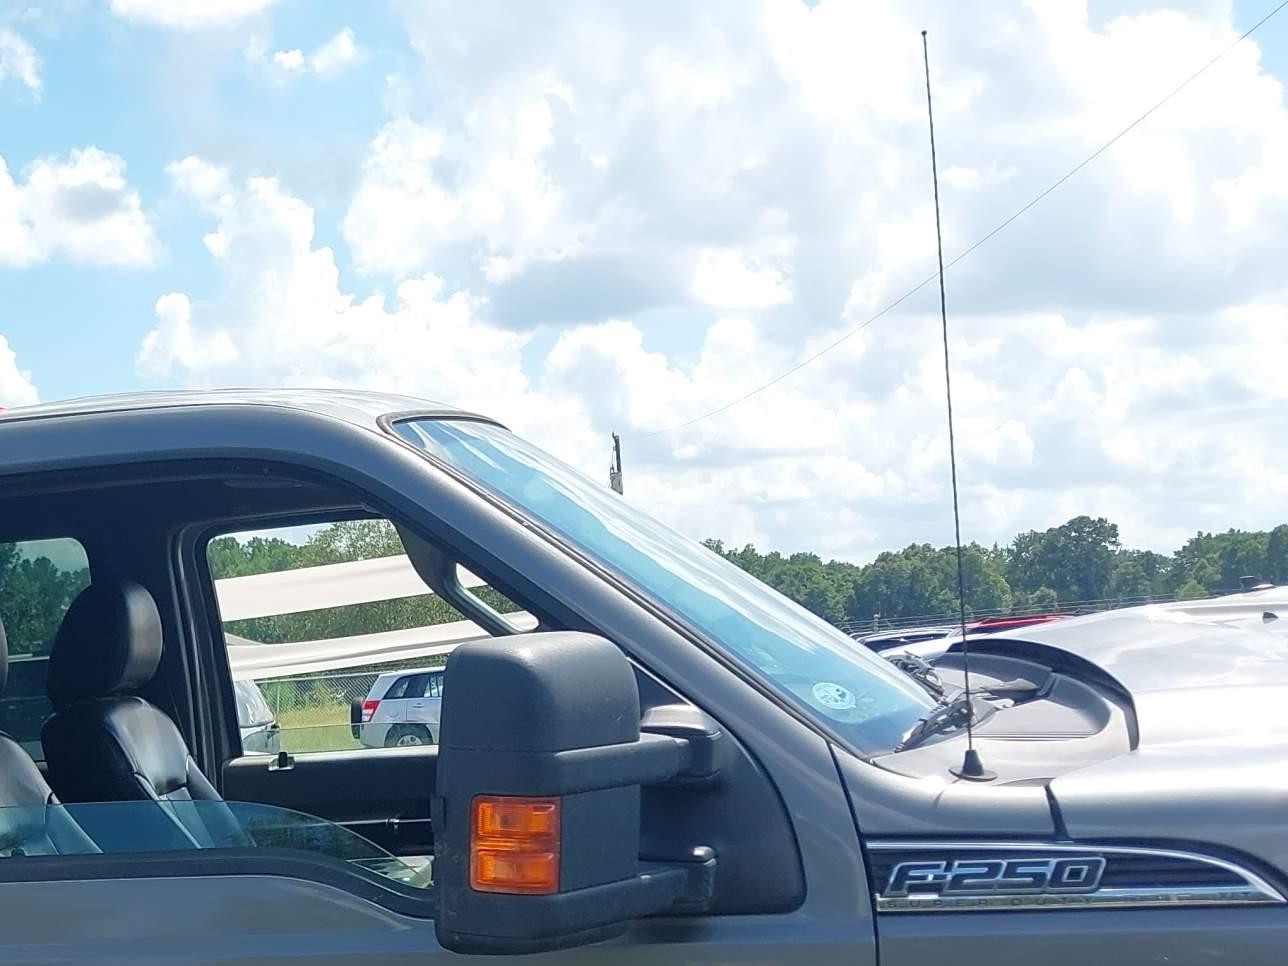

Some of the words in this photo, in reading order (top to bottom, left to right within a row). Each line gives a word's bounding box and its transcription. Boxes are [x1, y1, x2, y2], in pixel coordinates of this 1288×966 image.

[883, 857, 1106, 897] F-250
[887, 898, 991, 909] SUPER
[1010, 895, 1094, 907] DUTY
